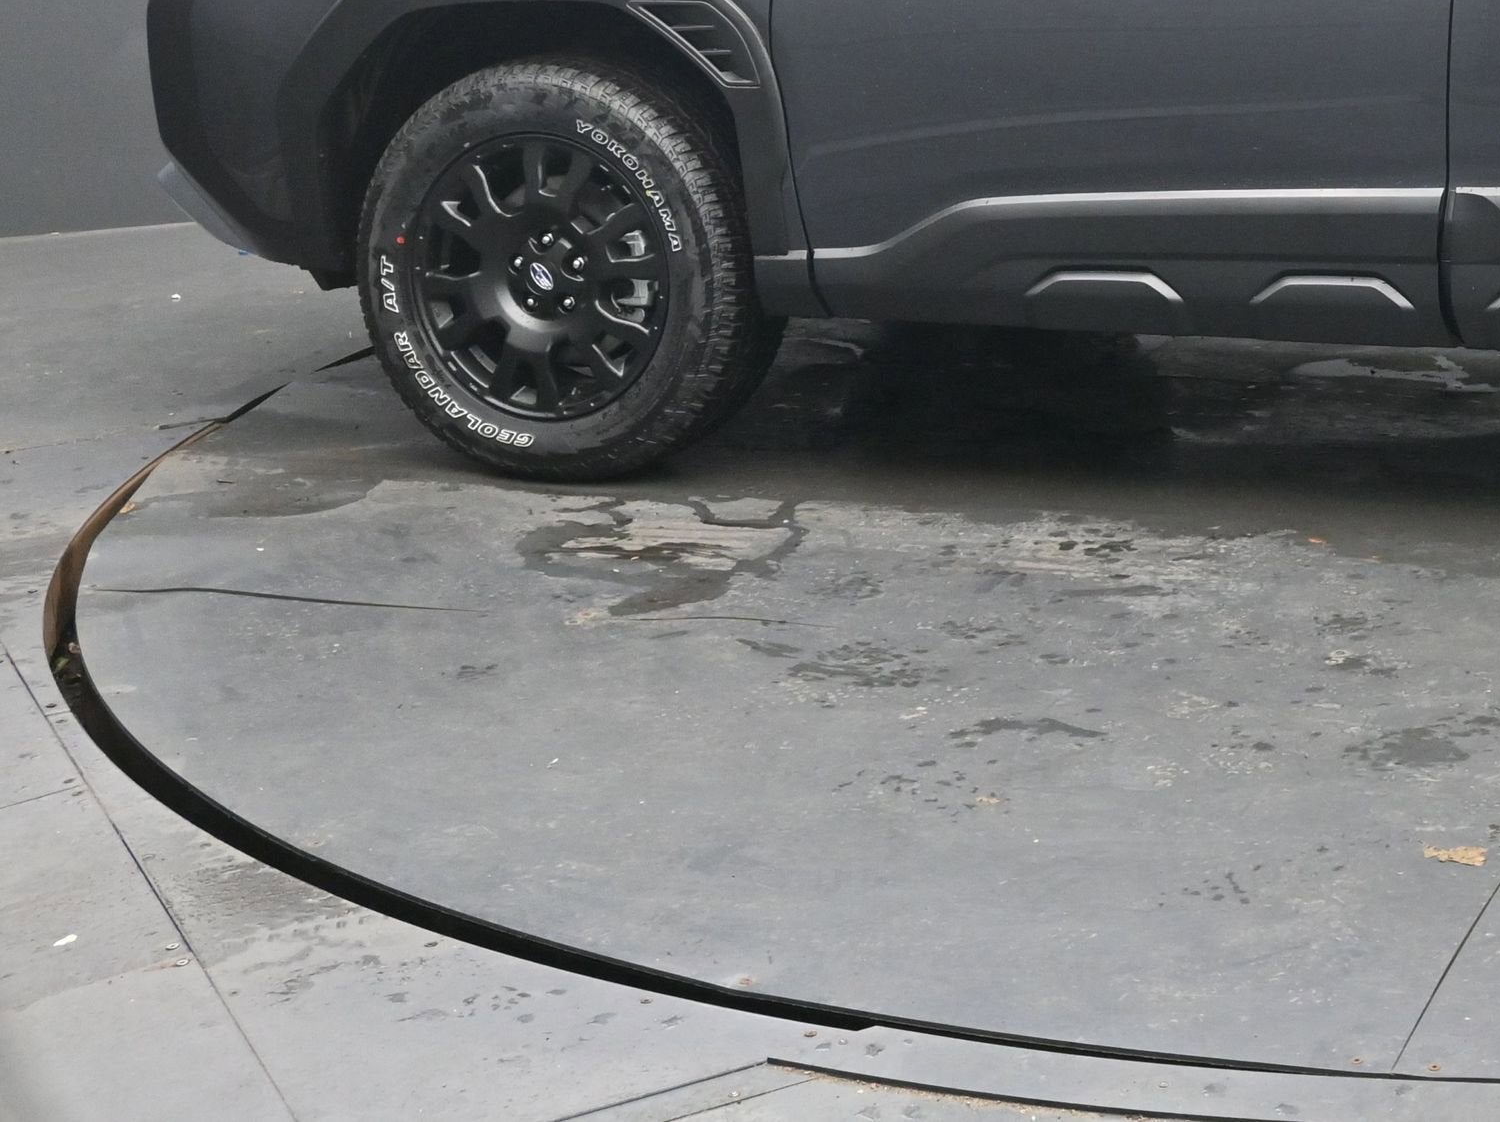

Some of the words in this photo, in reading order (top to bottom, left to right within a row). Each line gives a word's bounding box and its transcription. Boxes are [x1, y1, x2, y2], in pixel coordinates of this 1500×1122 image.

[575, 119, 683, 252] YOKOHAMA
[380, 255, 399, 313] A/T
[393, 331, 534, 448] GEOLANDAR
